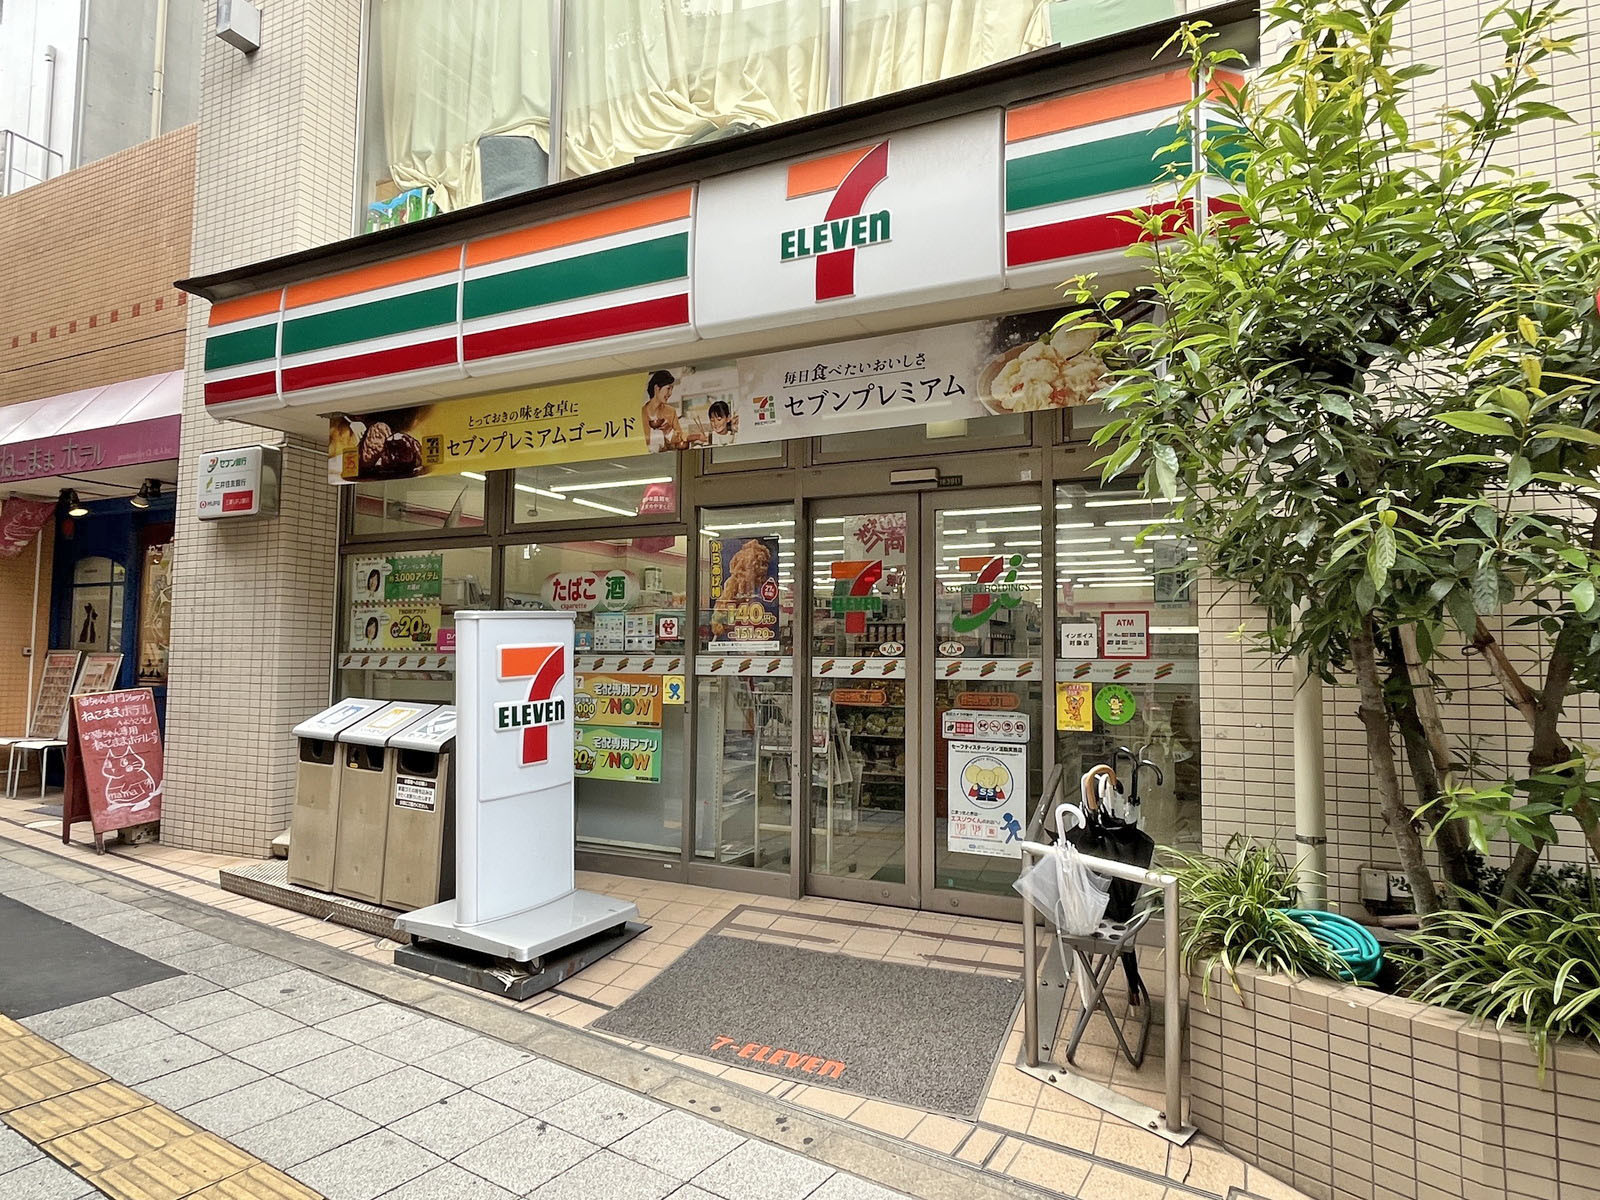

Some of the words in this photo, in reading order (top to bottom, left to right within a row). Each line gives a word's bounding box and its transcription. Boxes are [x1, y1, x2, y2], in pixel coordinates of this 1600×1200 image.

[786, 139, 889, 301] 7
[783, 352, 926, 385] 毎日食べたいおいしさ
[784, 374, 966, 417] セブンプレミアム
[468, 399, 580, 428] とっておきの味を食卓に
[447, 416, 637, 457] セブンプレミアムゴールド
[60, 437, 107, 469] ホテル
[552, 576, 597, 602] たばこ
[605, 575, 626, 600] 酒
[984, 583, 1031, 593] HOLDINGS
[1115, 619, 1135, 627] ATM
[593, 682, 659, 697] 宅配専用アプリ
[81, 704, 152, 722] ねこままホテル
[501, 646, 565, 764] 7
[600, 698, 651, 716] 7NOW
[592, 736, 658, 752] 宅配専用アプリ
[599, 751, 651, 770] 7NOW
[979, 787, 995, 797] SS
